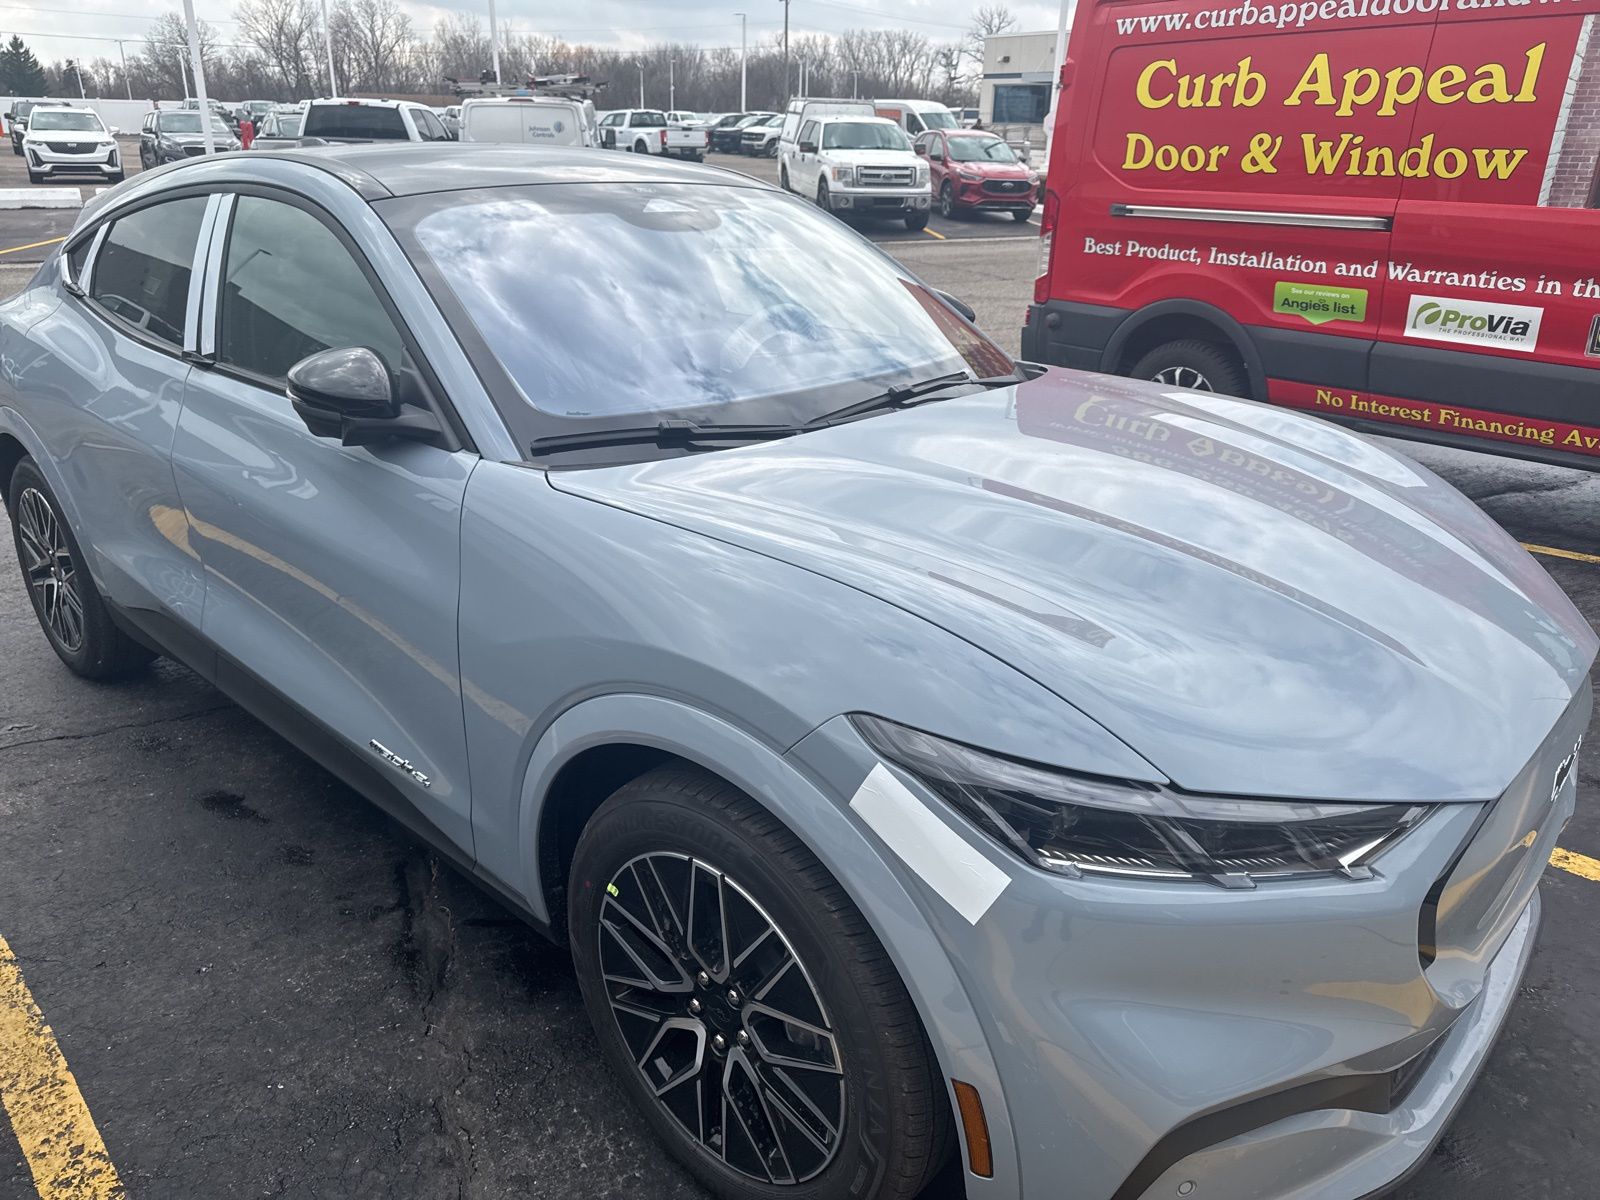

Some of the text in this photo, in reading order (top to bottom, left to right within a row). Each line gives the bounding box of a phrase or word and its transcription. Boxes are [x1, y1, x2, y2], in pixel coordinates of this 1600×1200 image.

[1136, 42, 1546, 117] Curb Appeal
[1121, 132, 1529, 180] Door & Window
[1083, 237, 1122, 256] Best
[1125, 240, 1202, 265] Product,
[1207, 247, 1328, 274] Installation
[1334, 260, 1379, 278] and
[1387, 261, 1527, 292] Warranties
[1535, 274, 1562, 295] in
[1315, 291, 1340, 299] reviews
[1333, 301, 1357, 314] list
[1440, 309, 1531, 336] ProVia
[1453, 329, 1507, 341] PROFESSIONAL
[1315, 389, 1600, 449] No Interest Financing Av
